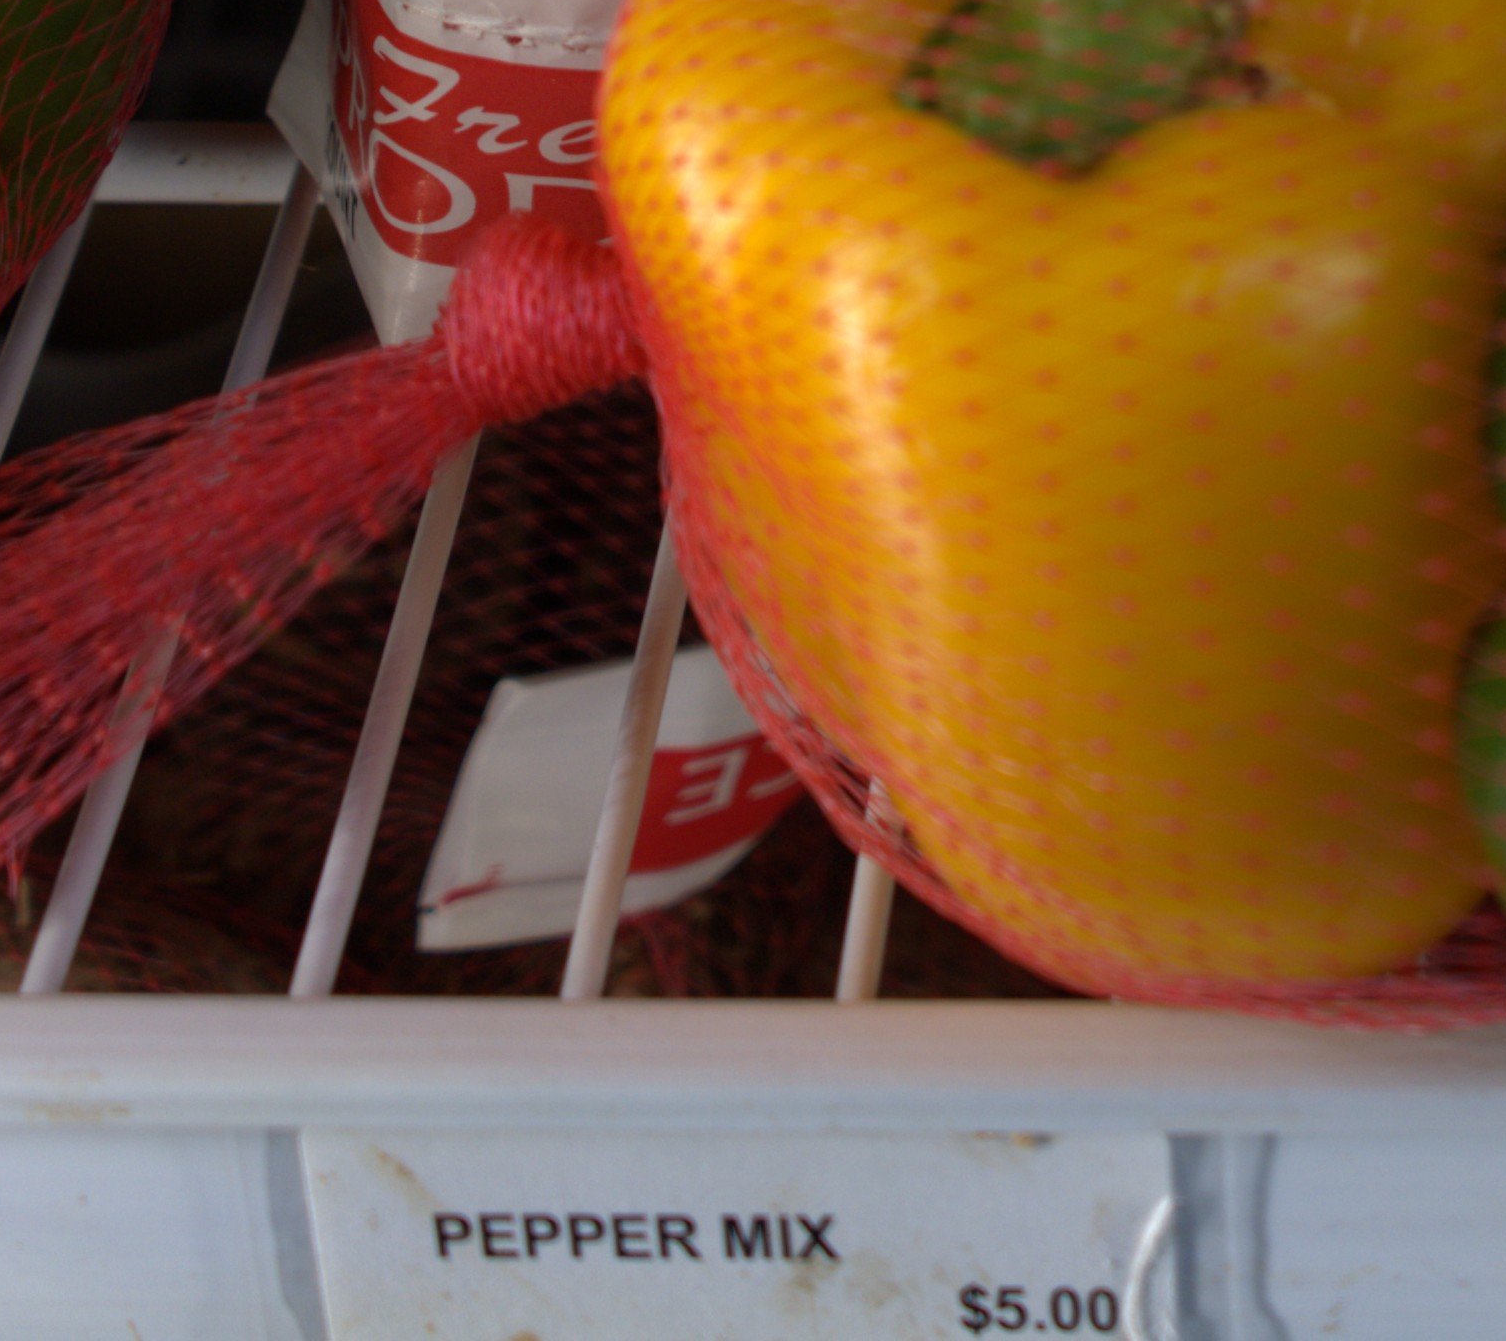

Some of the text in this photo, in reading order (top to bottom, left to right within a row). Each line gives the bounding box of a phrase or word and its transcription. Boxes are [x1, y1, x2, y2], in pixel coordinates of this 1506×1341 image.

[435, 1213, 839, 1262] PEPPER MIX
[959, 1283, 1118, 1334] $5.00
